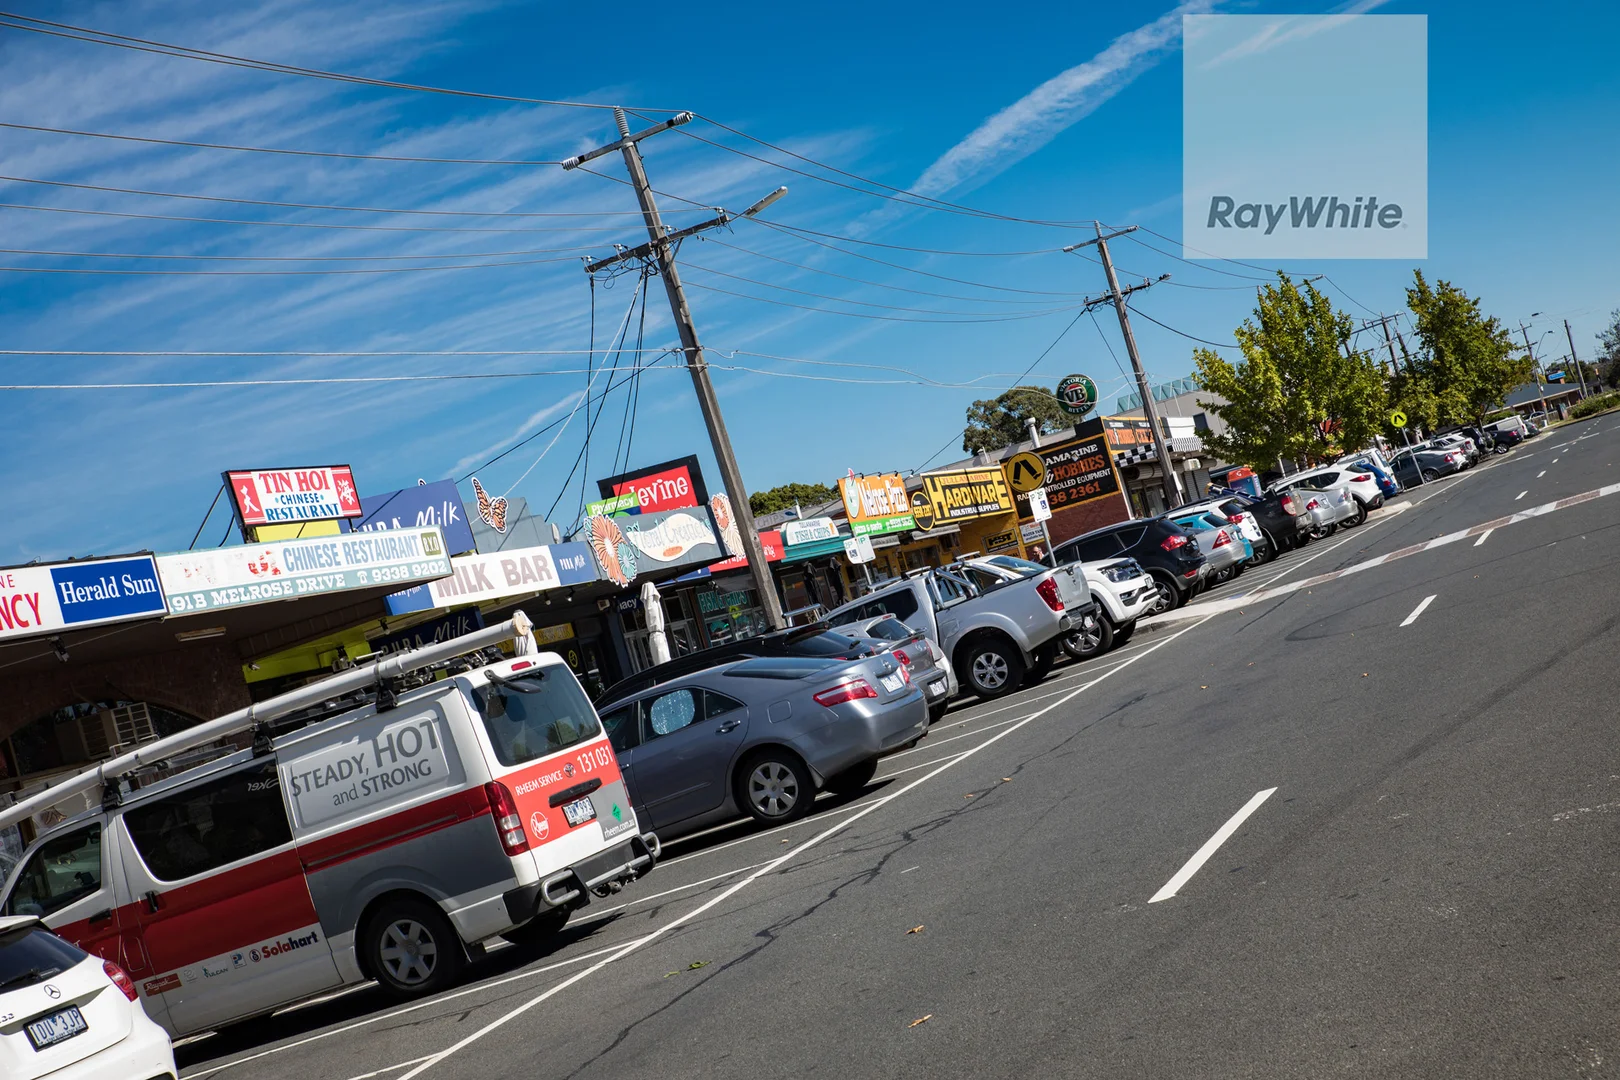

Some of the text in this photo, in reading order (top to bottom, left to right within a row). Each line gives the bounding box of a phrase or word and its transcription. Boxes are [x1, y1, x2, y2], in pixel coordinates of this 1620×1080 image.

[1059, 377, 1087, 392] VICTORIA
[1065, 387, 1084, 403] VB
[259, 470, 330, 494] TIN HOI
[627, 477, 689, 508] evine
[924, 471, 1012, 519] HARDWARE
[1045, 479, 1077, 495] NTROLLED
[1077, 467, 1112, 486] EQUIPMENT
[1070, 481, 1102, 499] 2361
[265, 503, 340, 521] RESTAURANT
[280, 493, 319, 505] CHINESE
[591, 497, 635, 517] Pharmacy
[950, 503, 1000, 517] INDUSTRIAL SUPPLIES
[416, 501, 460, 529] Milk
[283, 543, 342, 573] CHINESE
[342, 535, 420, 564] RESTAURANT
[372, 560, 447, 583] 9338 9202
[437, 554, 554, 598] MILK BAR
[58, 573, 157, 605] Herald Sun
[211, 580, 293, 606] MELROSE
[295, 574, 346, 596] DRIVE
[434, 616, 472, 644] Milk
[291, 717, 440, 797] STEADY, HOT
[577, 744, 614, 773] 131 031
[333, 759, 432, 806] and STRONG
[515, 769, 565, 798] RHEEM SERVICE
[604, 818, 635, 839] rheem.com.au
[261, 932, 319, 958] Solahart
